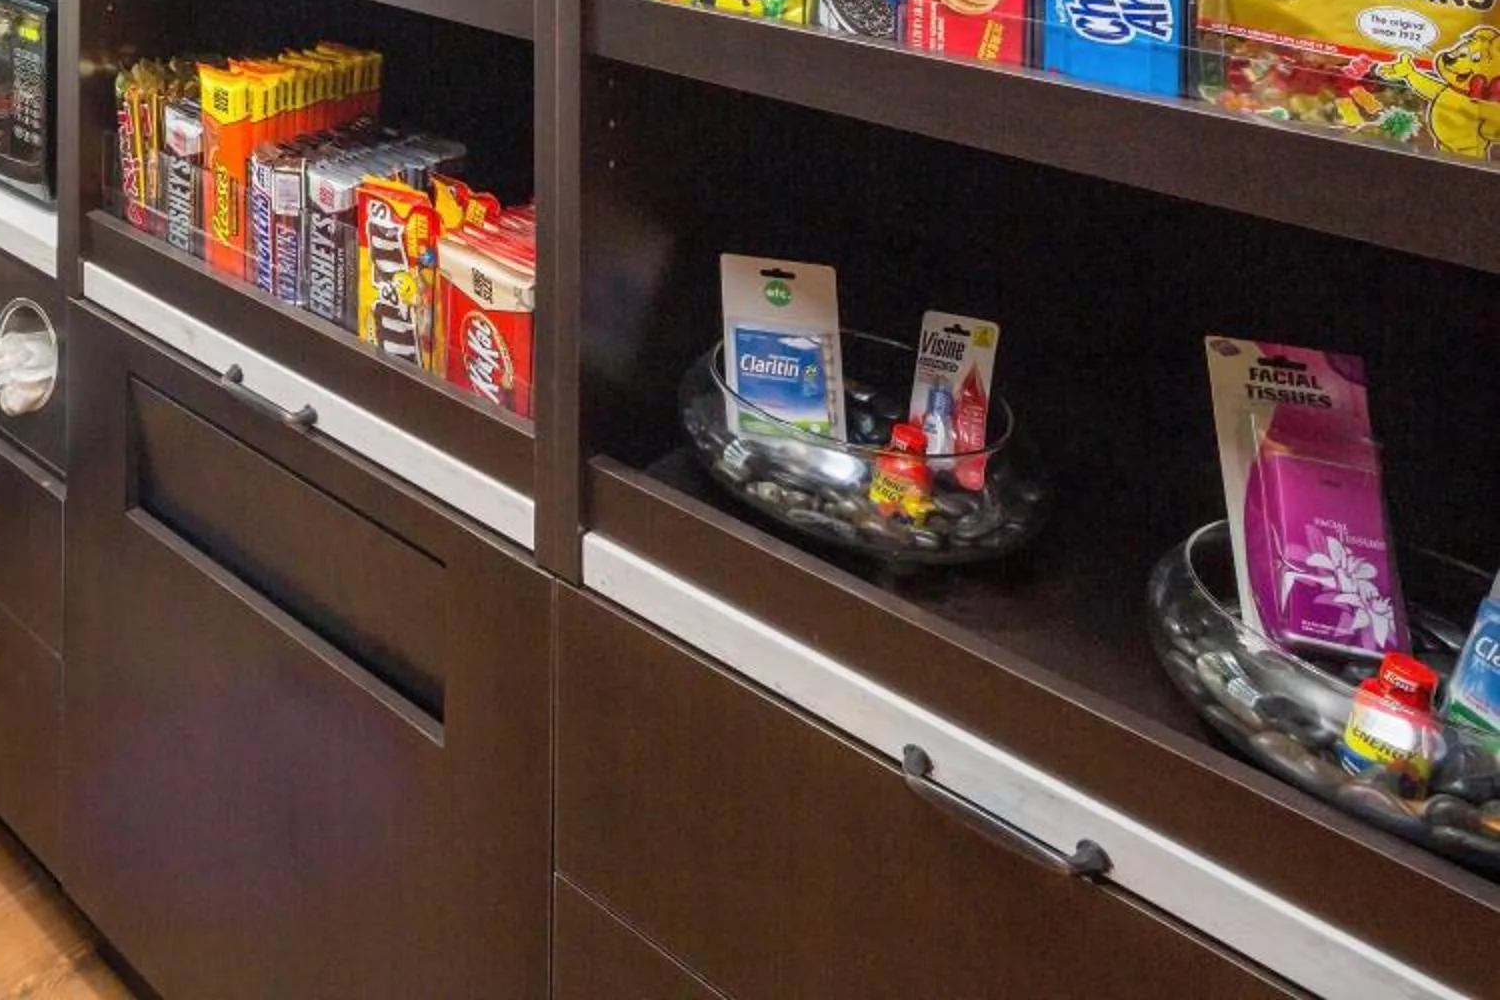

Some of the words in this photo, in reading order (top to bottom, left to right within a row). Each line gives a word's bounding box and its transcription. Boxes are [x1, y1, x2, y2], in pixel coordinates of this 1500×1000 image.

[167, 155, 191, 250] ERSHEY'S
[310, 213, 336, 320] ERSHEY'S
[739, 353, 800, 377] Claritin
[1248, 366, 1324, 390] FACIAL
[1244, 382, 1333, 409] TISSUES
